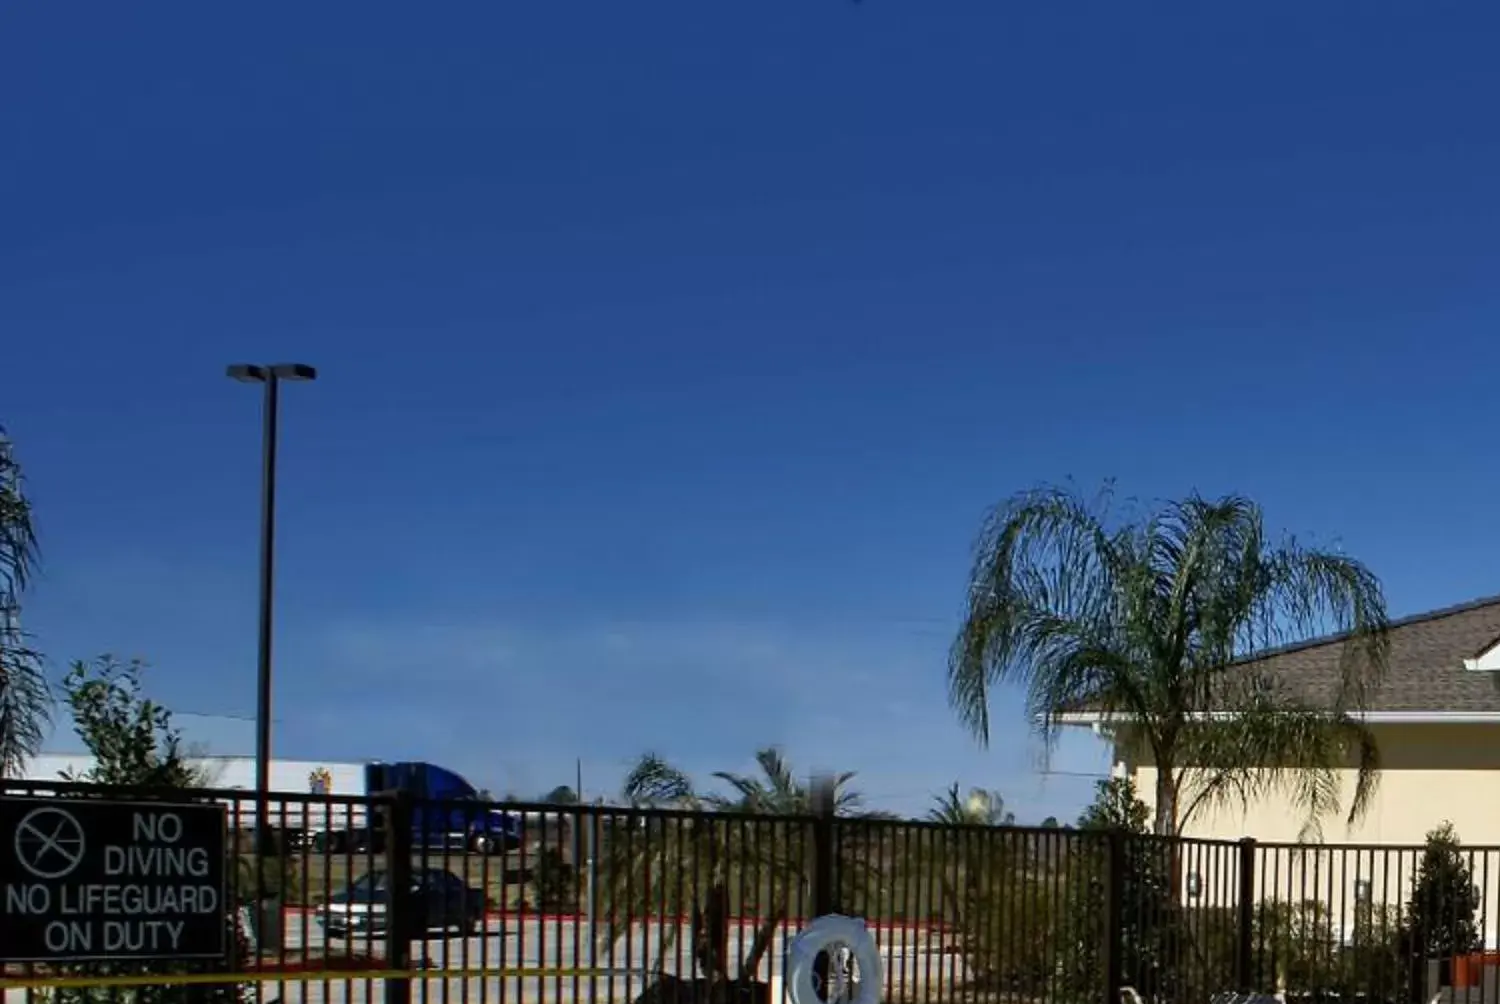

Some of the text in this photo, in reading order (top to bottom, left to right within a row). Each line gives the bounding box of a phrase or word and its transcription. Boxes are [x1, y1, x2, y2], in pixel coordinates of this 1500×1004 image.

[133, 812, 183, 842] NO
[104, 846, 208, 876] DIVING
[6, 884, 218, 915] NO LIFEGUARD
[45, 921, 184, 950] ON DUTY
